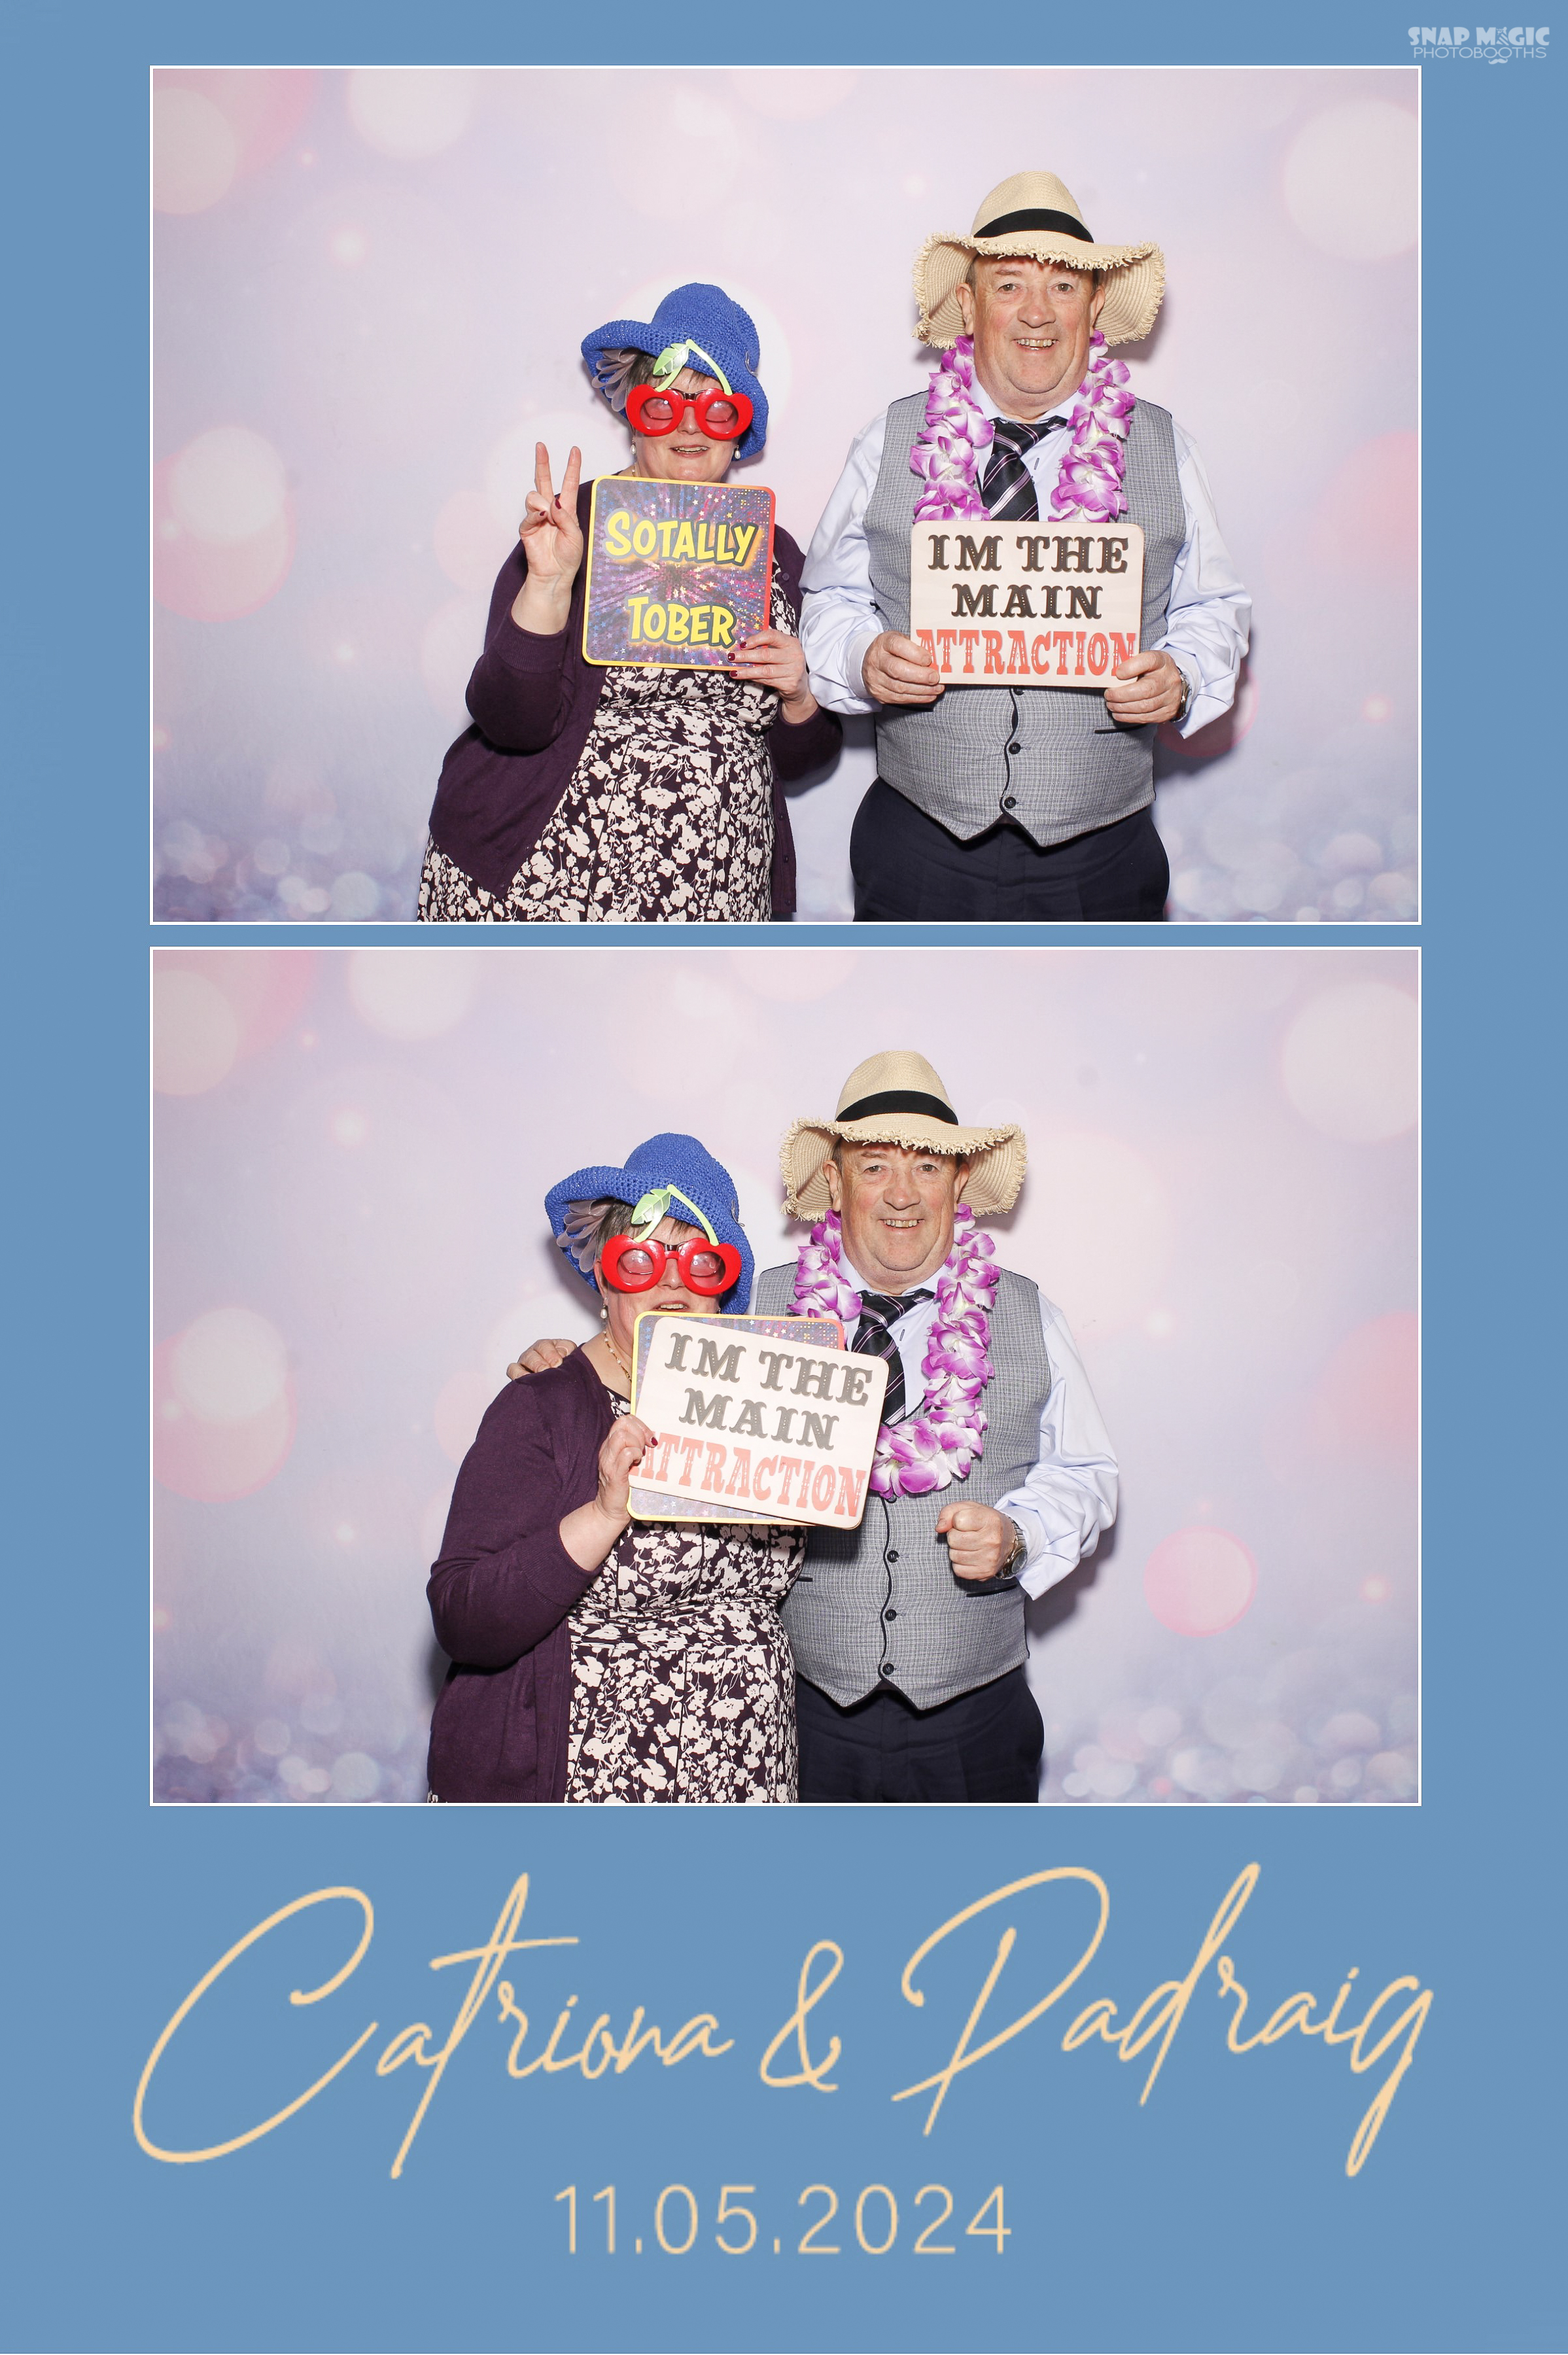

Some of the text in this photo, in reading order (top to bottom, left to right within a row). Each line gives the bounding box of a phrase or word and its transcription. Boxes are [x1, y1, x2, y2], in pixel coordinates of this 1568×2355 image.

[604, 509, 757, 565] SOTALLY
[928, 534, 1129, 574] IM THE
[627, 595, 735, 646] TOBER
[950, 583, 1104, 620] MAIN
[916, 629, 1136, 676] ATTRACTION
[664, 1332, 873, 1407] IM THE
[678, 1387, 840, 1451] MAIN
